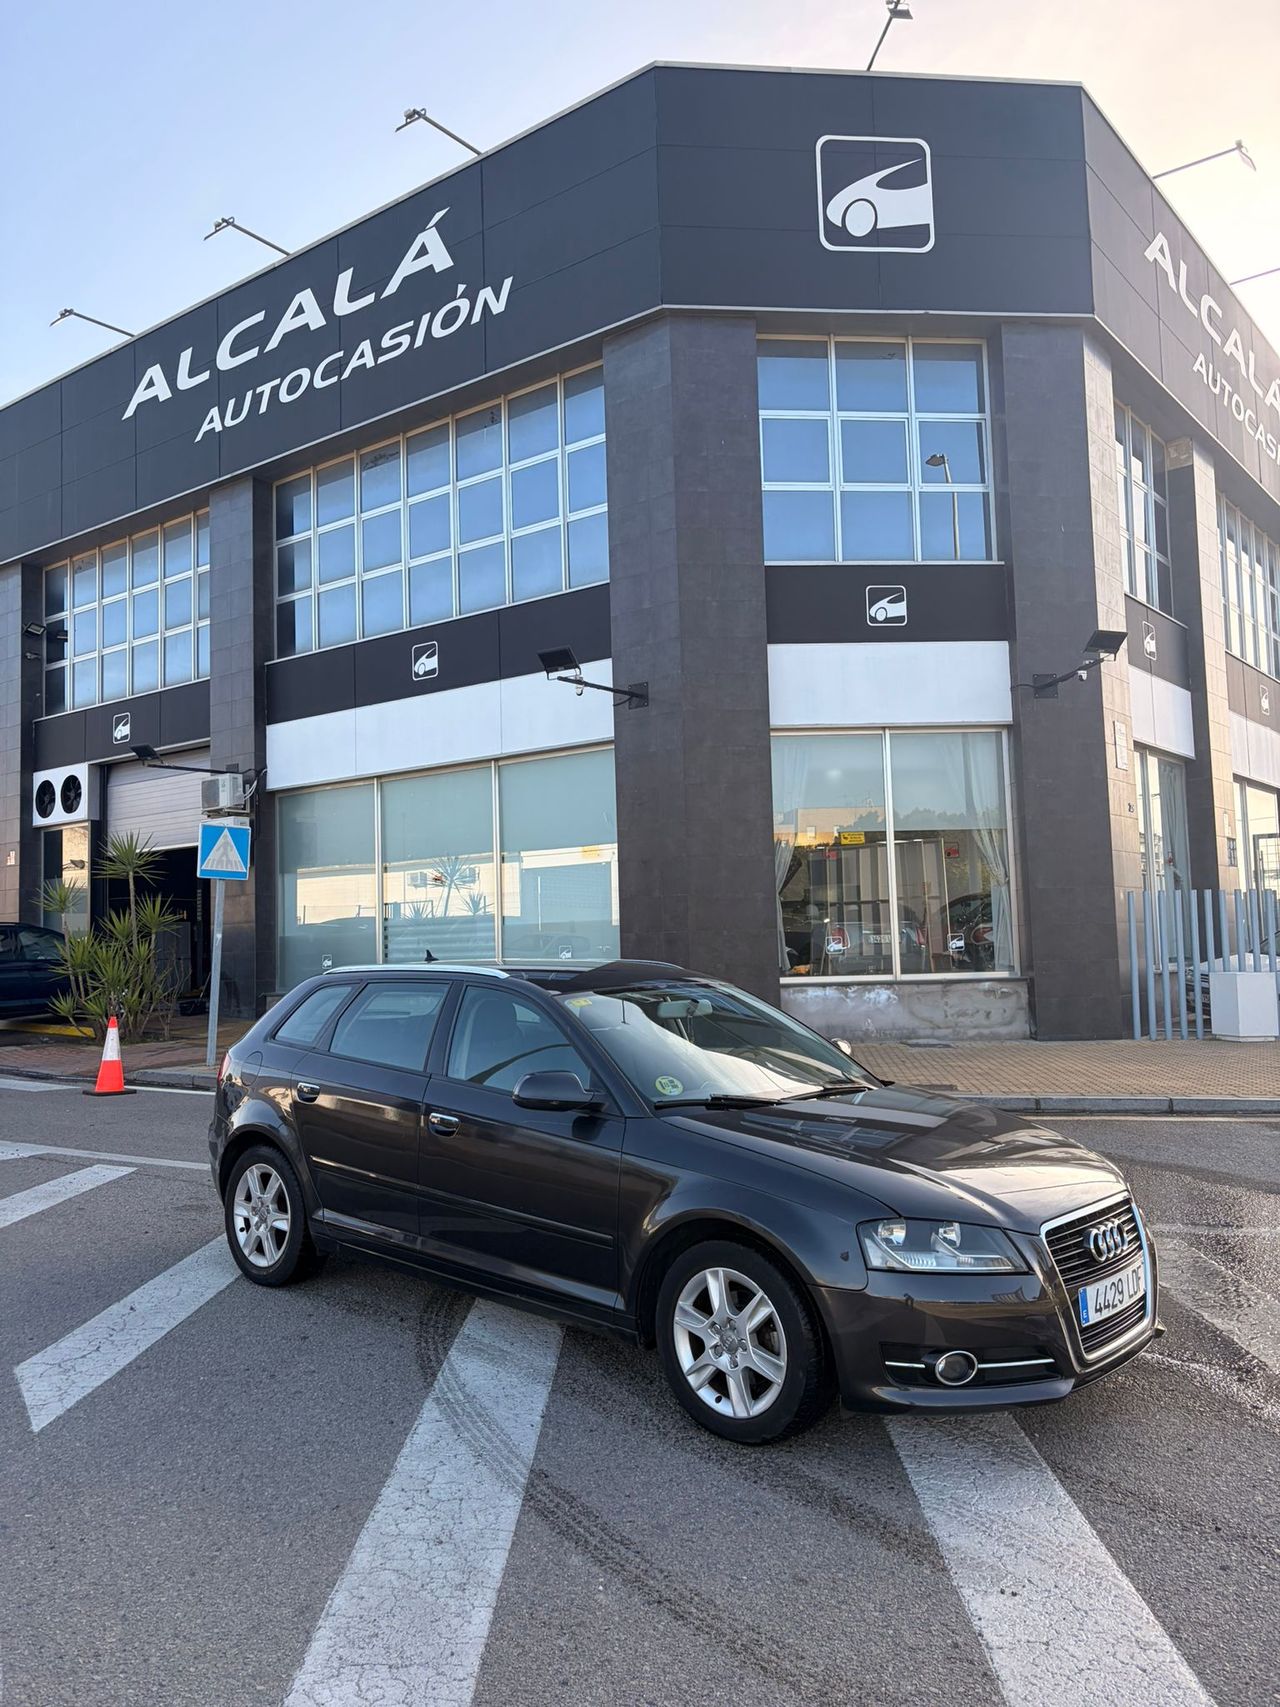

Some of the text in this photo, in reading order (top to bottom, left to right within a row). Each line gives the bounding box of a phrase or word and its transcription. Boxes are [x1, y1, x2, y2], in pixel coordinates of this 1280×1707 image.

[122, 207, 454, 420] ALCALÁ
[194, 276, 514, 443] AUTOCASIÓN
[1094, 1277, 1124, 1315] 4429
